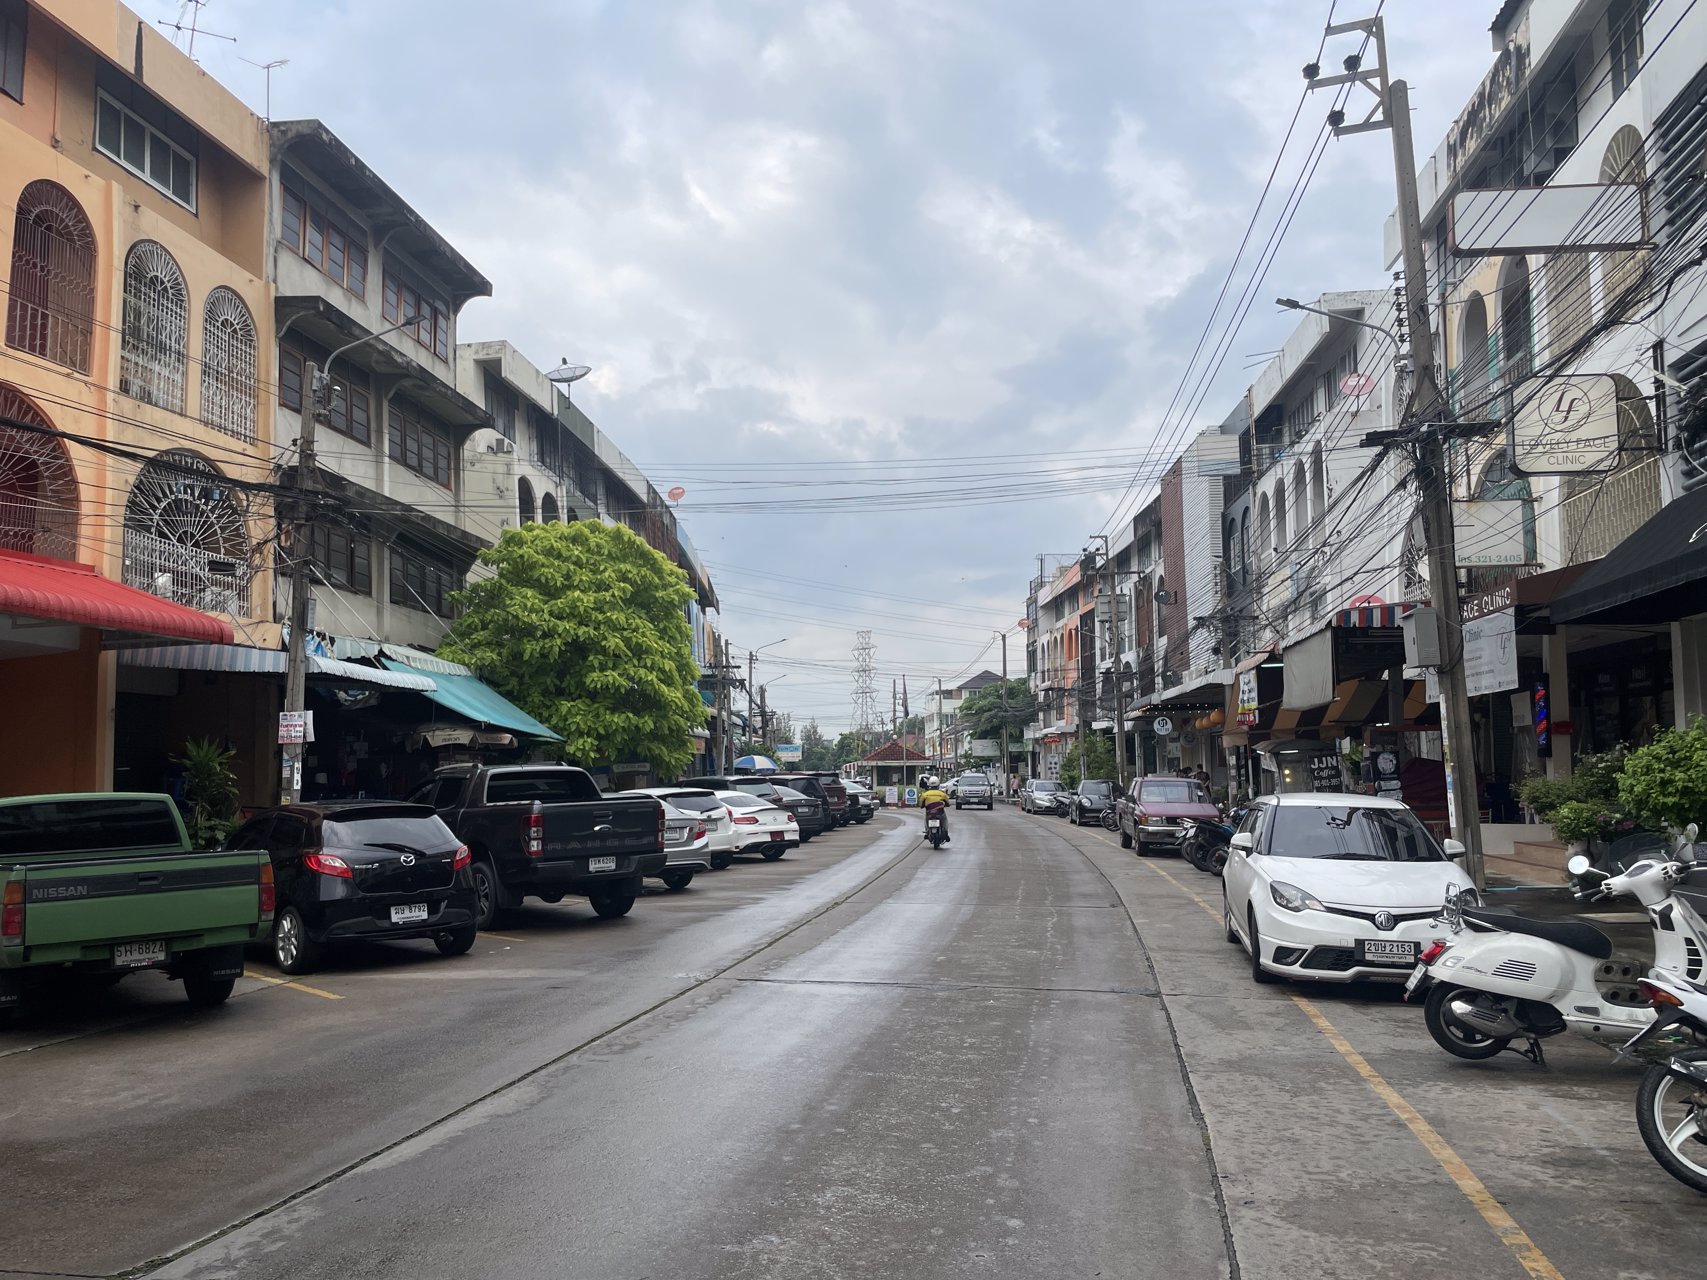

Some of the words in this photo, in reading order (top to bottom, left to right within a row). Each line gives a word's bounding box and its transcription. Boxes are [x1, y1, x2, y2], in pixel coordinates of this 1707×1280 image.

[1521, 438, 1571, 451] LOVELY
[1576, 437, 1611, 449] FACE
[1547, 454, 1587, 465] CLINIC
[1482, 587, 1511, 612] CLINIC
[1314, 769, 1337, 777] Coffee
[32, 885, 88, 899] NISSAN
[409, 904, 427, 914] 8792
[1376, 913, 1392, 927] MG
[1389, 943, 1412, 953] 2153
[213, 968, 241, 976] NISSAN
